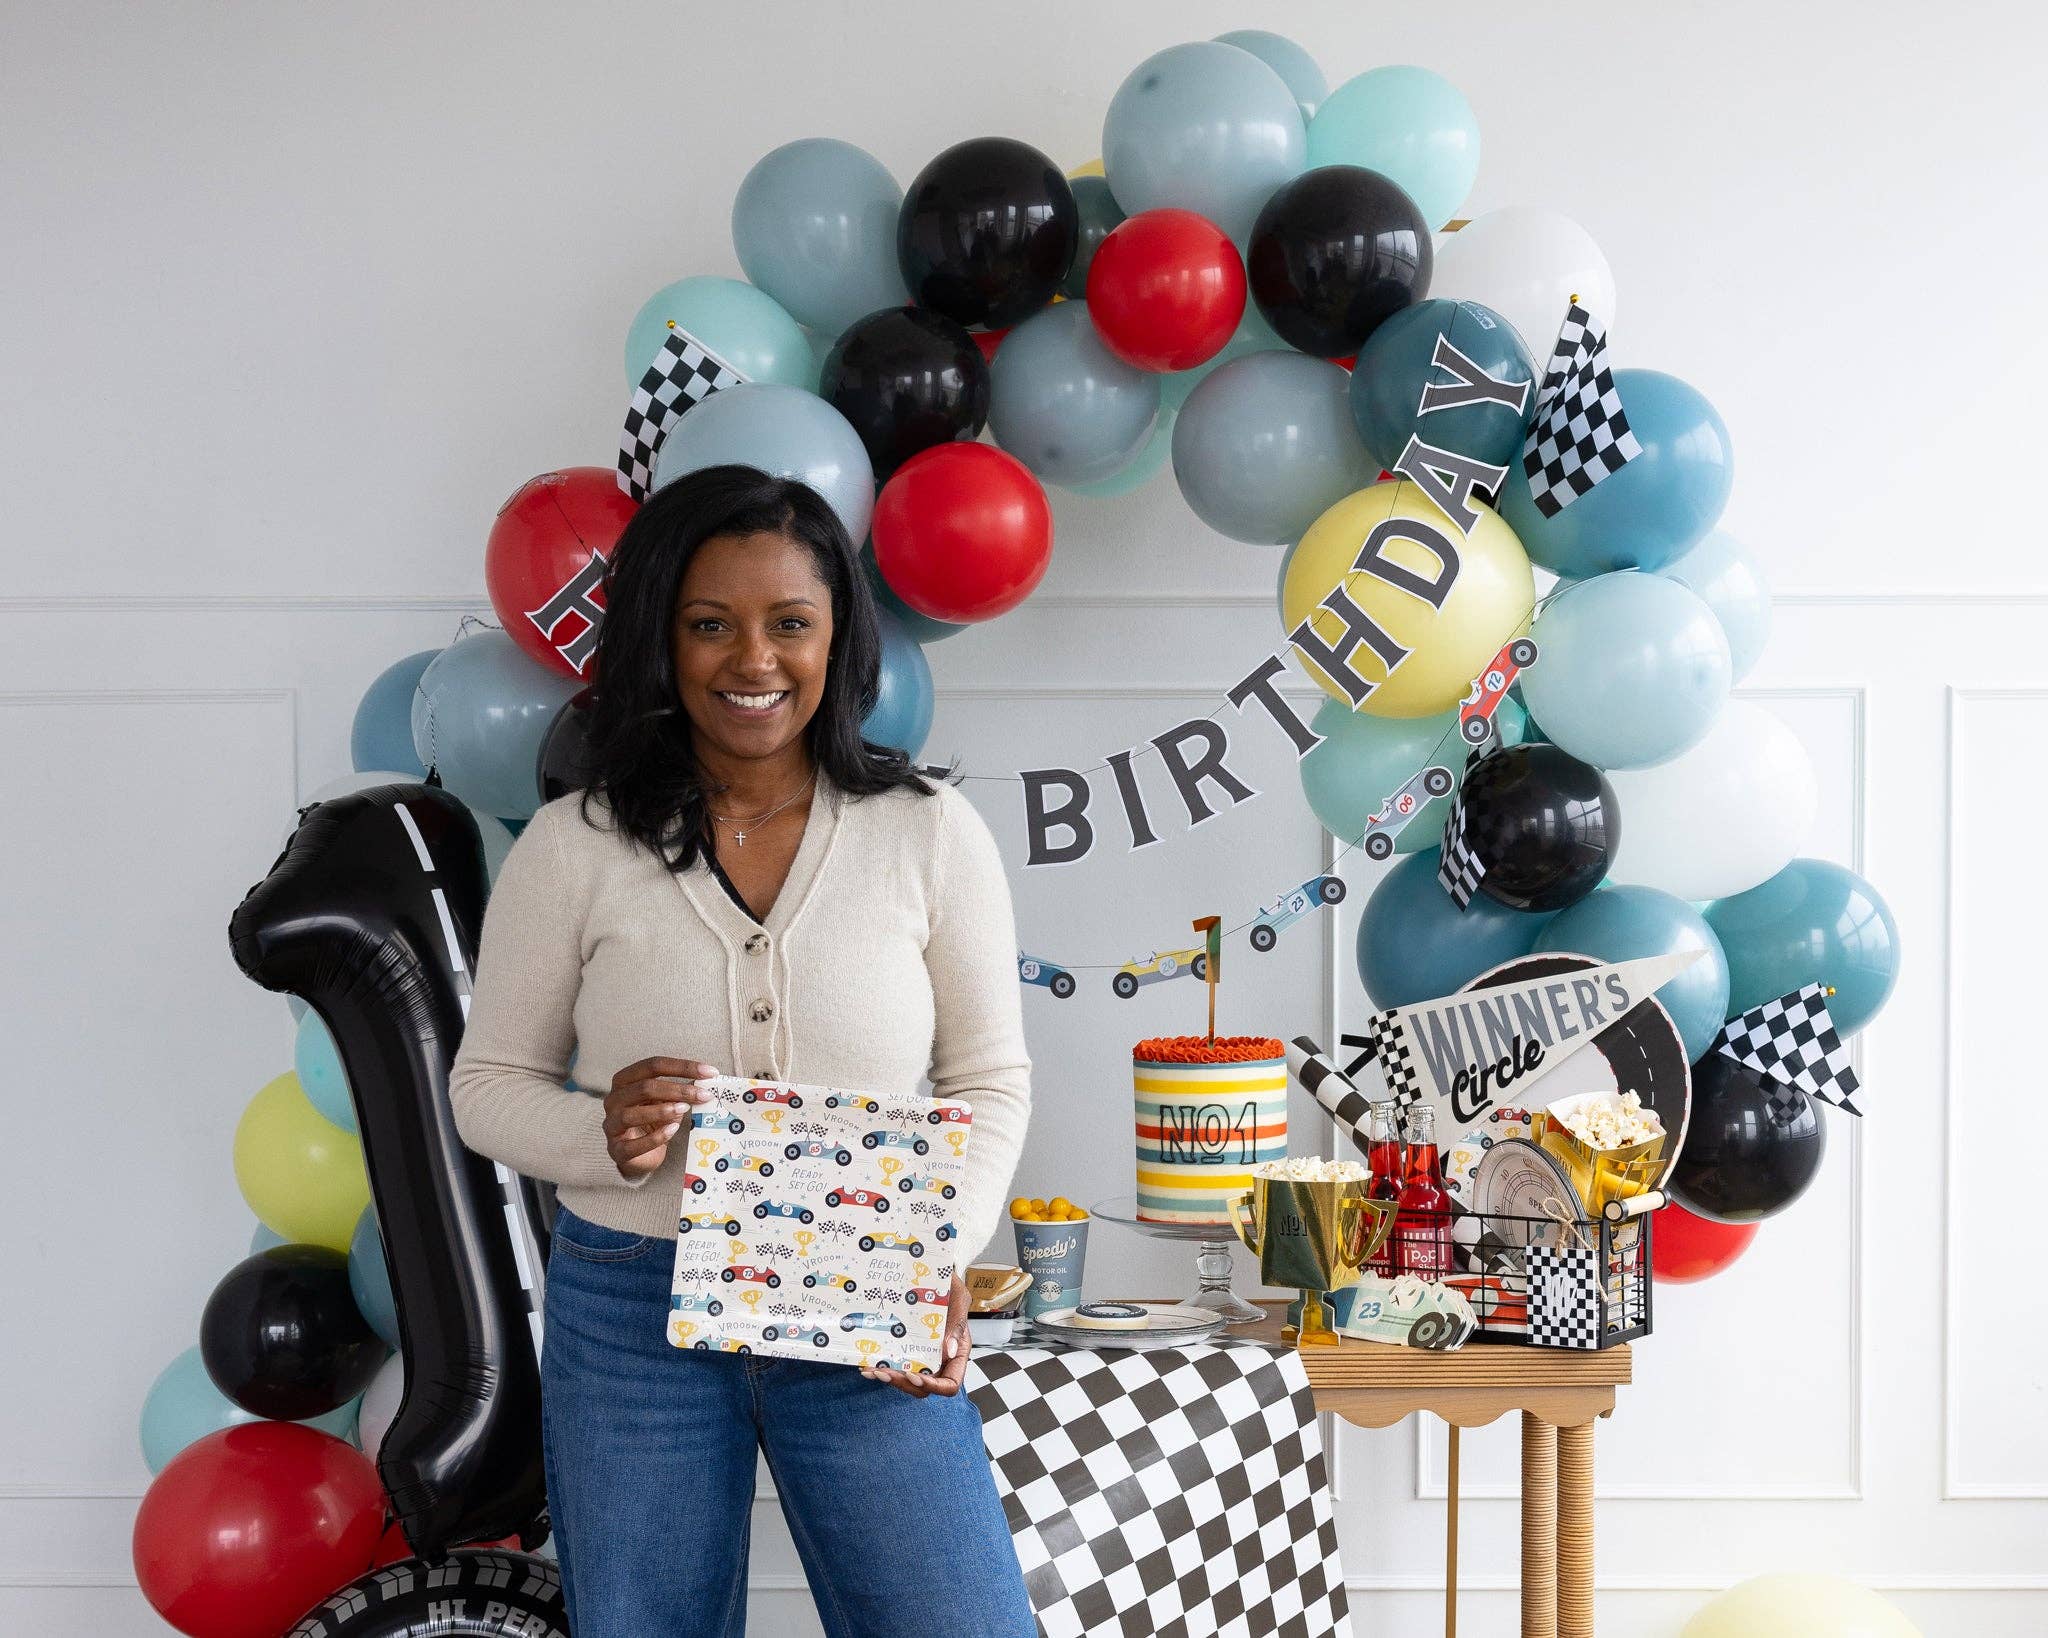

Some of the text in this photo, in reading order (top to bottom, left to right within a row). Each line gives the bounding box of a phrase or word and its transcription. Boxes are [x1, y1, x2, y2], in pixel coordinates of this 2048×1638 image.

[1019, 333, 1531, 868] BIRTHDAY
[1291, 895, 1305, 912] 23
[1162, 959, 1176, 974] 20
[1408, 973, 1630, 1097] WINNER'S
[1451, 1034, 1546, 1124] Circle
[791, 1168, 824, 1180] READY
[787, 1180, 828, 1193] SET GO!
[686, 1239, 718, 1250] READY
[1023, 1236, 1077, 1264] Speedy's
[683, 1251, 721, 1262] SET GO!
[869, 1258, 902, 1269] READY
[865, 1270, 905, 1282] SET GO!
[1357, 1302, 1382, 1319] 23
[428, 1599, 467, 1624] HI
